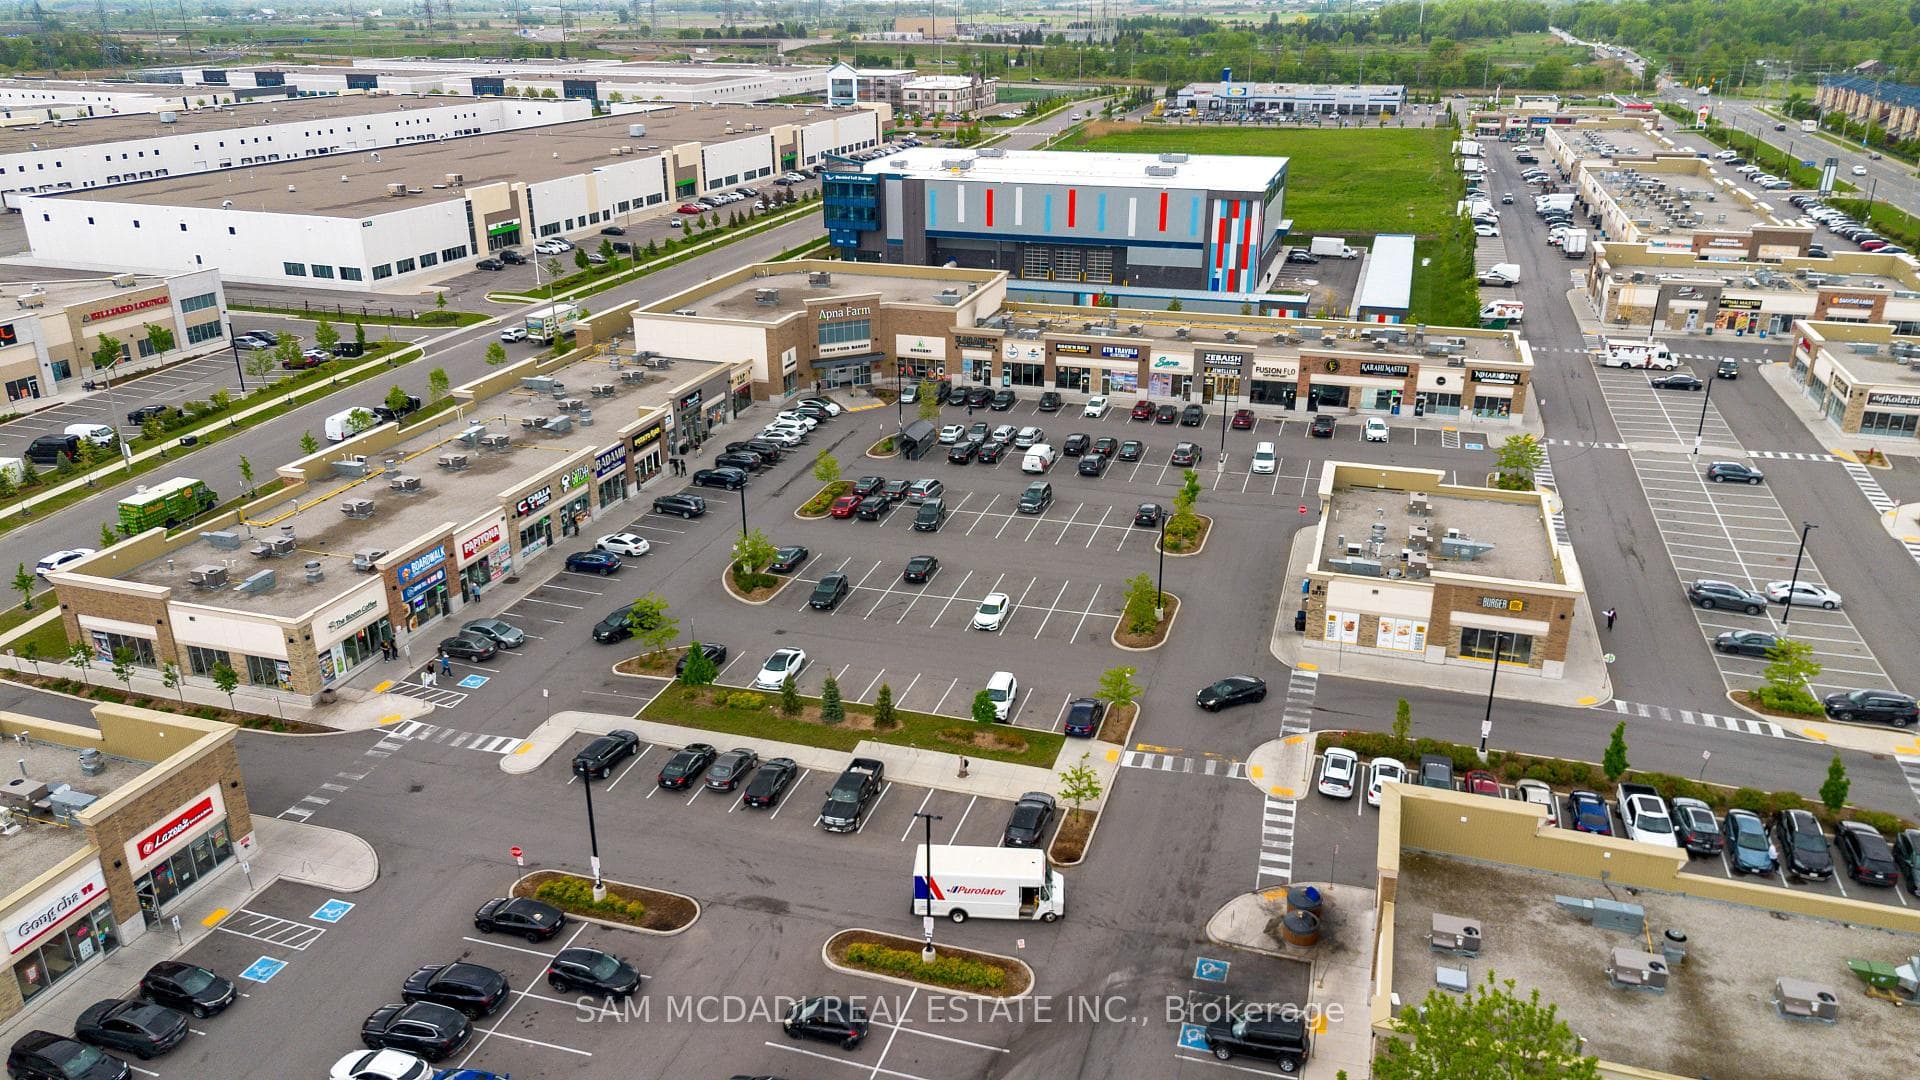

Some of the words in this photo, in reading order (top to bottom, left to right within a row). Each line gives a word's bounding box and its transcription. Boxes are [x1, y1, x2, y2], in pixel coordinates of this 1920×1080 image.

[90, 303, 134, 321] BILLIARD
[134, 295, 169, 311] LOUNGE
[819, 308, 844, 320] Apna
[846, 306, 871, 317] Farm
[1114, 347, 1138, 356] TRAVELS
[1205, 354, 1242, 362] ZEBAISH
[1256, 366, 1282, 375] FUSION
[1283, 368, 1296, 376] FLO
[1385, 364, 1408, 373] MASTER
[411, 545, 446, 573] BOARDWALK
[1482, 597, 1508, 609] BURGER
[336, 617, 345, 626] The
[362, 600, 378, 612] Coffee
[957, 885, 1006, 896] Purolator
[18, 909, 57, 938] Gong
[57, 890, 79, 913] cha
